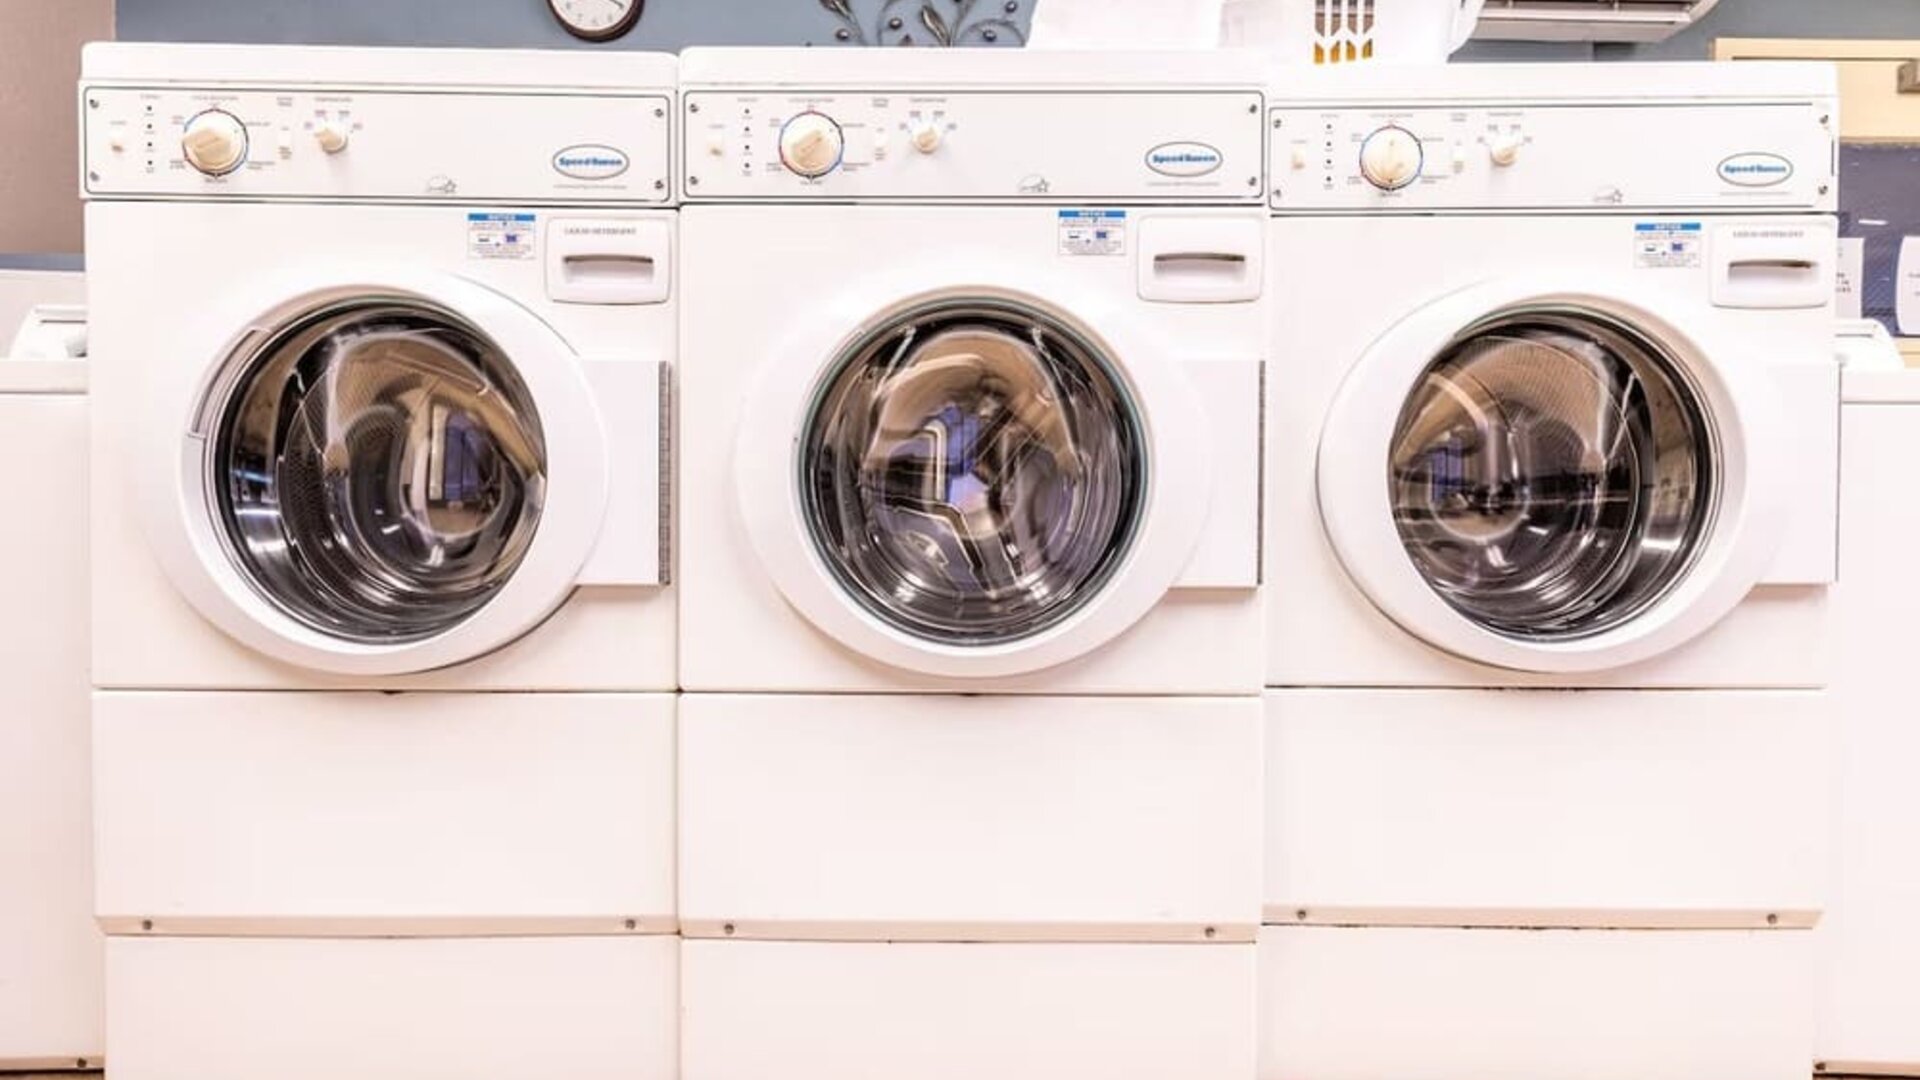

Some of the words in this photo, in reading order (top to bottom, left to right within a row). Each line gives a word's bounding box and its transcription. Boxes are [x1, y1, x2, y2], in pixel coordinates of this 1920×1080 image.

[559, 157, 590, 166] Speed
[1153, 154, 1183, 163] Speed
[1724, 164, 1755, 173] Speed
